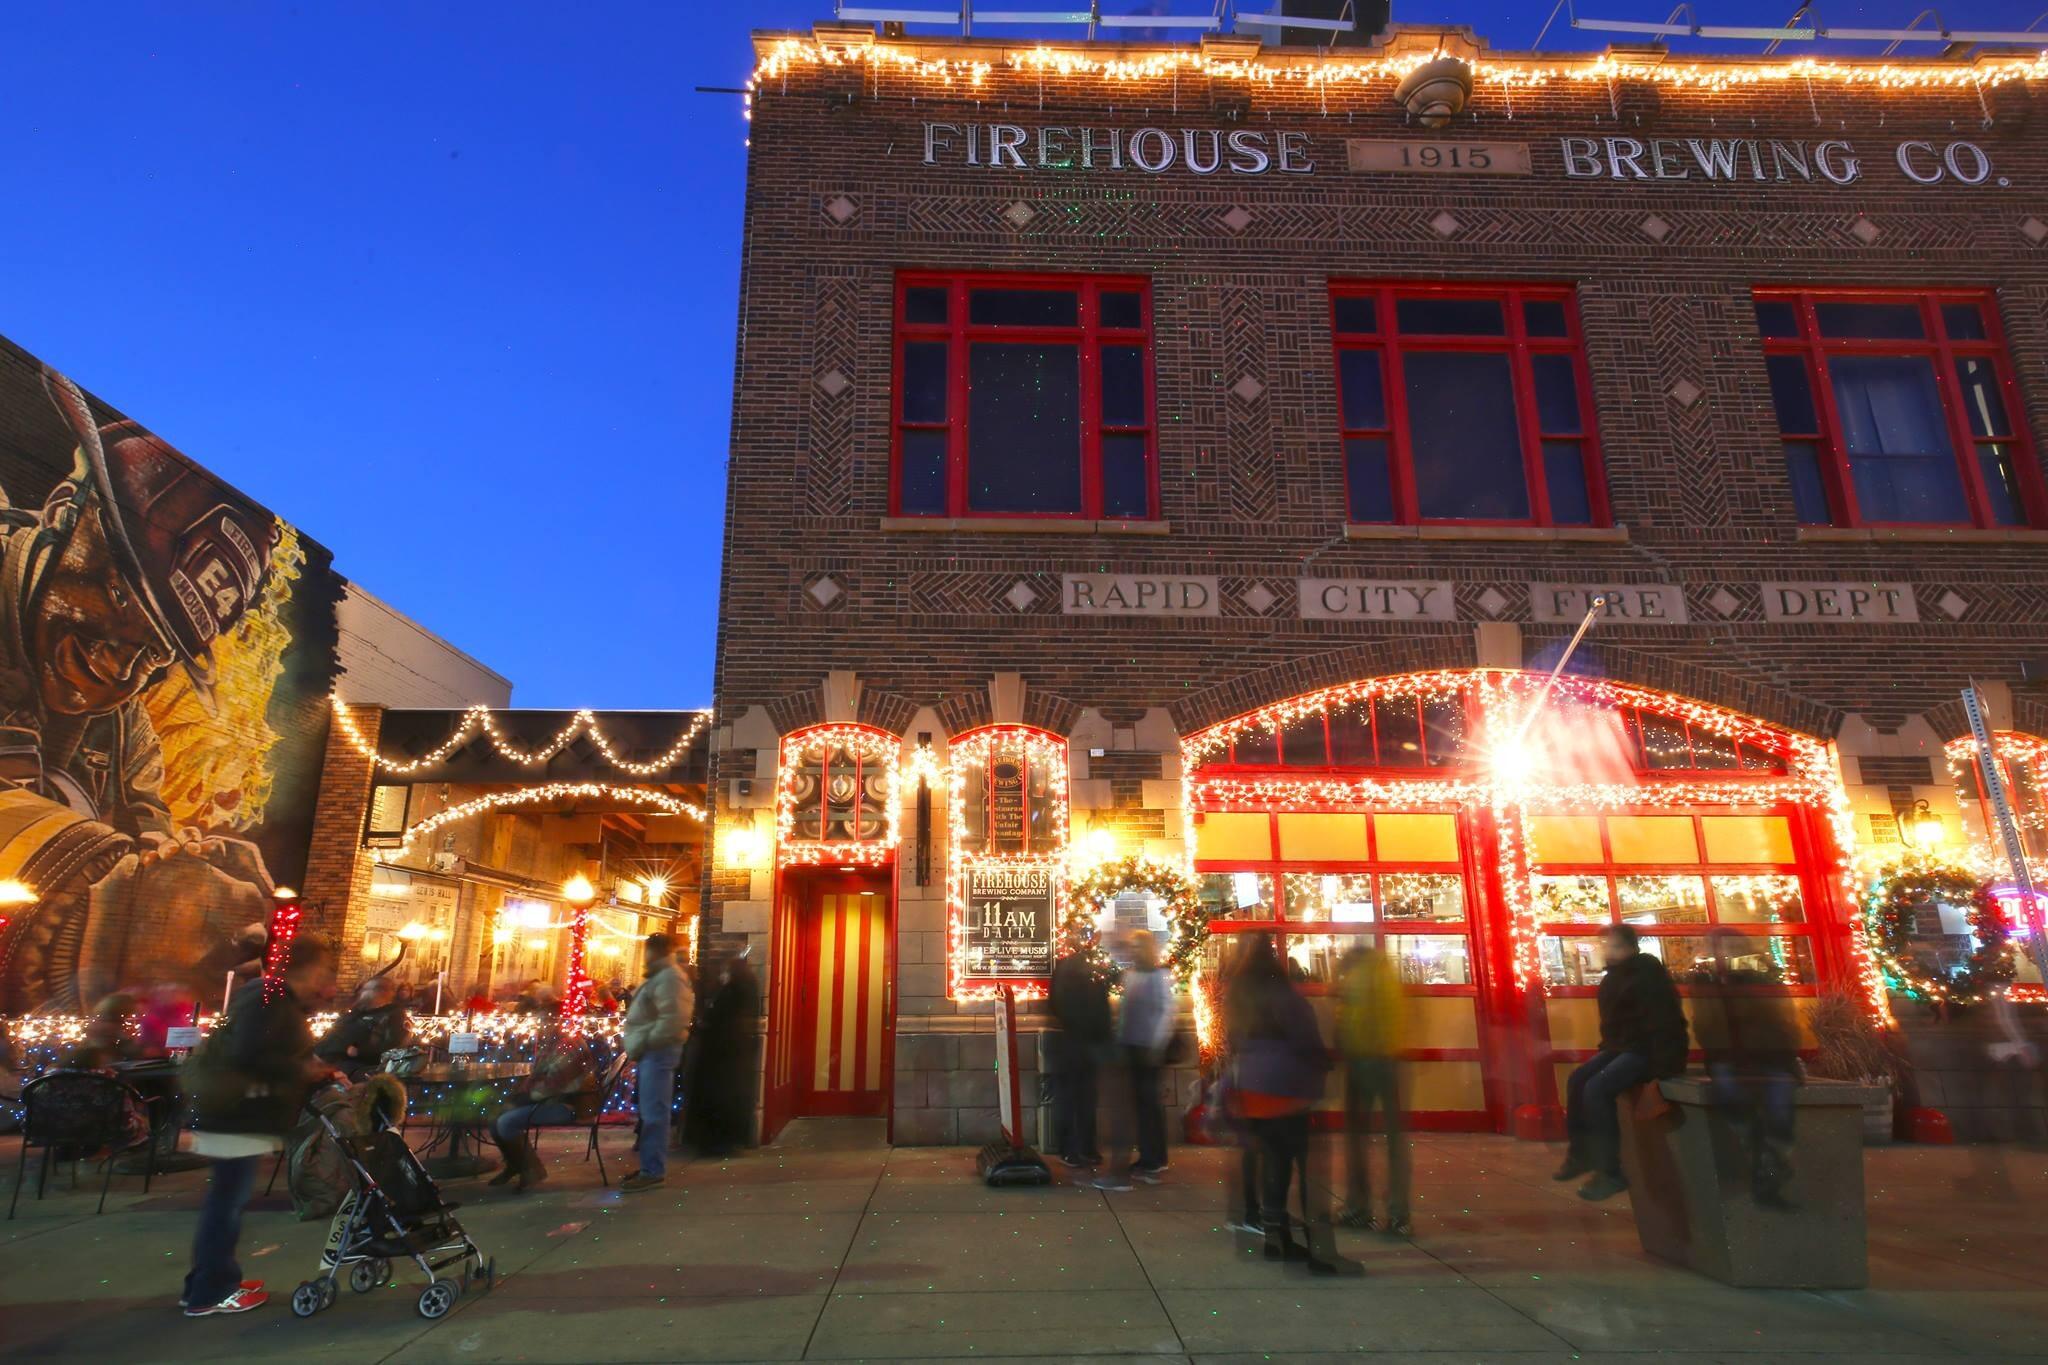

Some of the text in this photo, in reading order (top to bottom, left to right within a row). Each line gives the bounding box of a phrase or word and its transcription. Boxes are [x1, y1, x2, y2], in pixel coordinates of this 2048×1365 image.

[921, 120, 1316, 175] FIREHOUSE
[1402, 146, 1492, 169] 1915
[1560, 136, 2011, 187] BREWING CO.
[175, 576, 212, 635] HOUSE
[196, 558, 241, 619] E4
[1069, 580, 1901, 618] RAPID CITY FIRE DEPT
[972, 873, 1047, 888] FIREHOUSE
[983, 927, 1036, 939] DAILY
[997, 946, 1018, 954] LIVE
